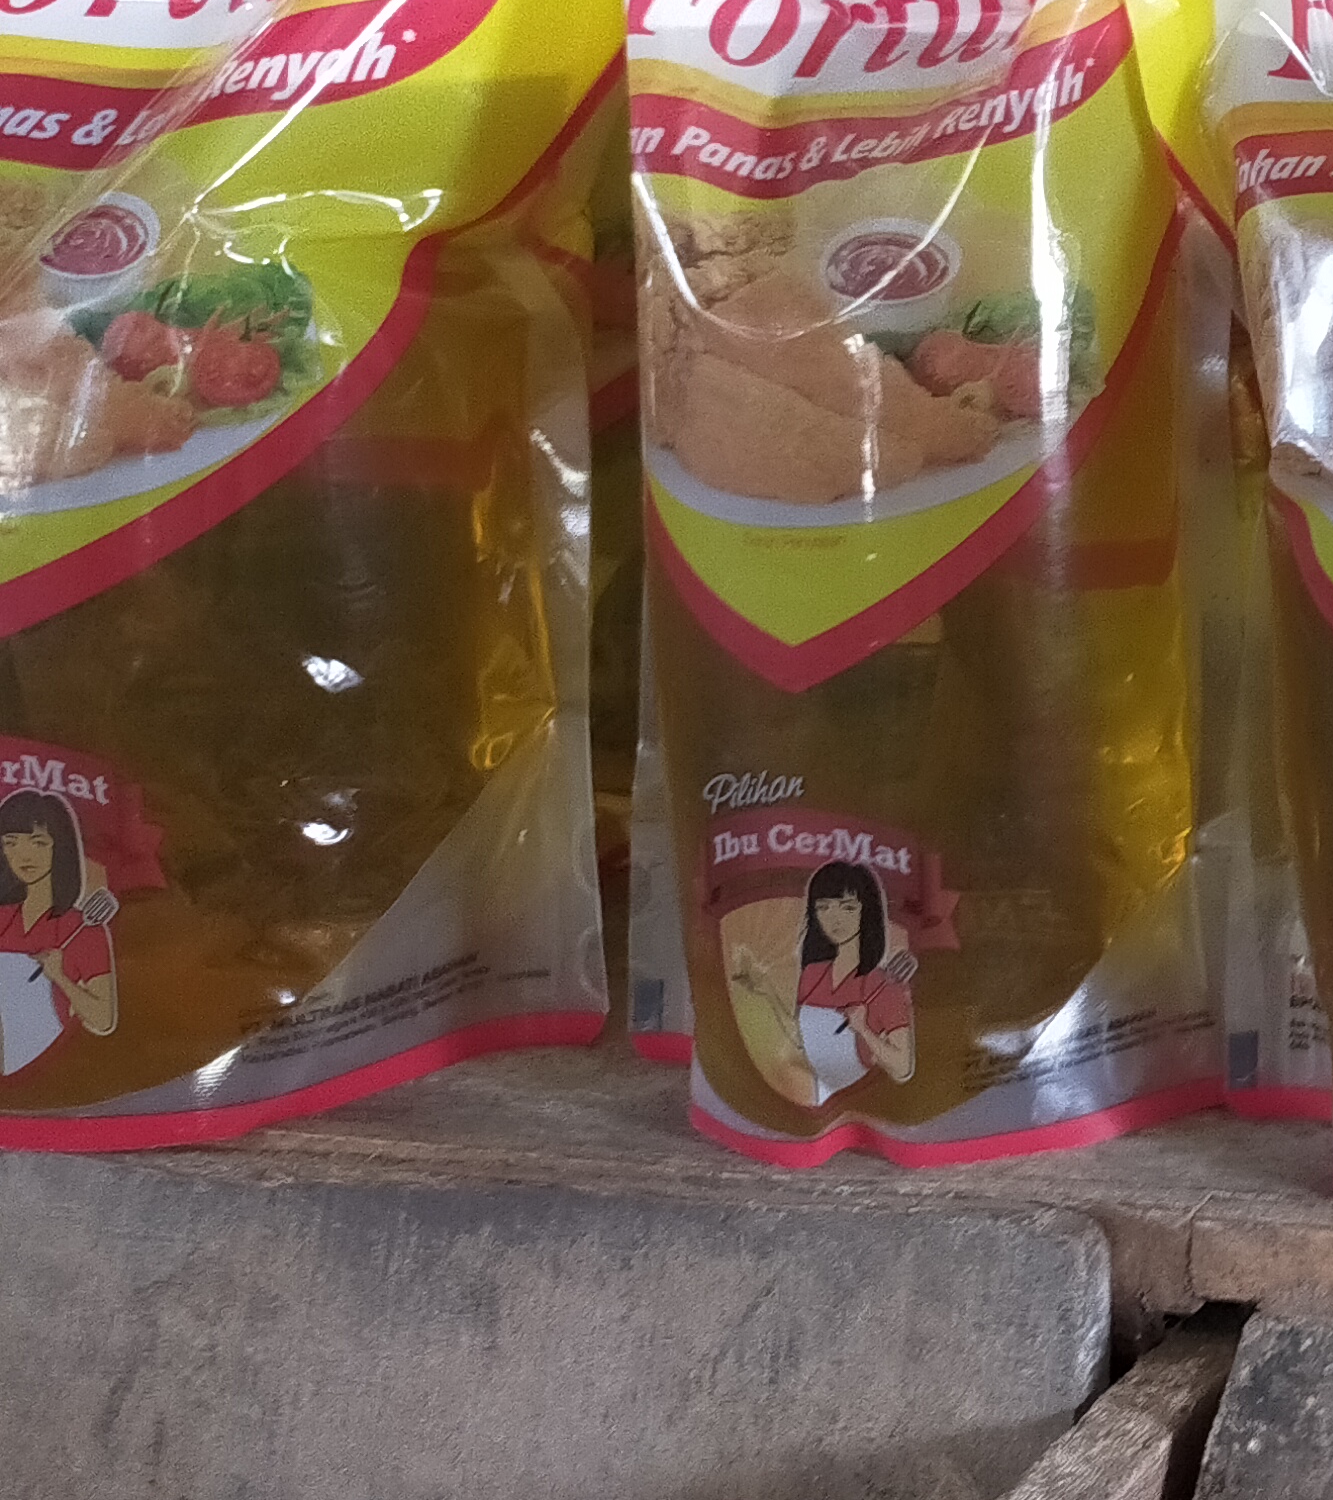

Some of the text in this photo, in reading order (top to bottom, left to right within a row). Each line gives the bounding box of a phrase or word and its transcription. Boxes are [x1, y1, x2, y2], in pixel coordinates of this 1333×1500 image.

[70, 108, 119, 146] &
[673, 125, 796, 182] Panas
[799, 137, 821, 172] &
[702, 769, 805, 815] Pilihan
[712, 823, 913, 875] Ibu CerMat
